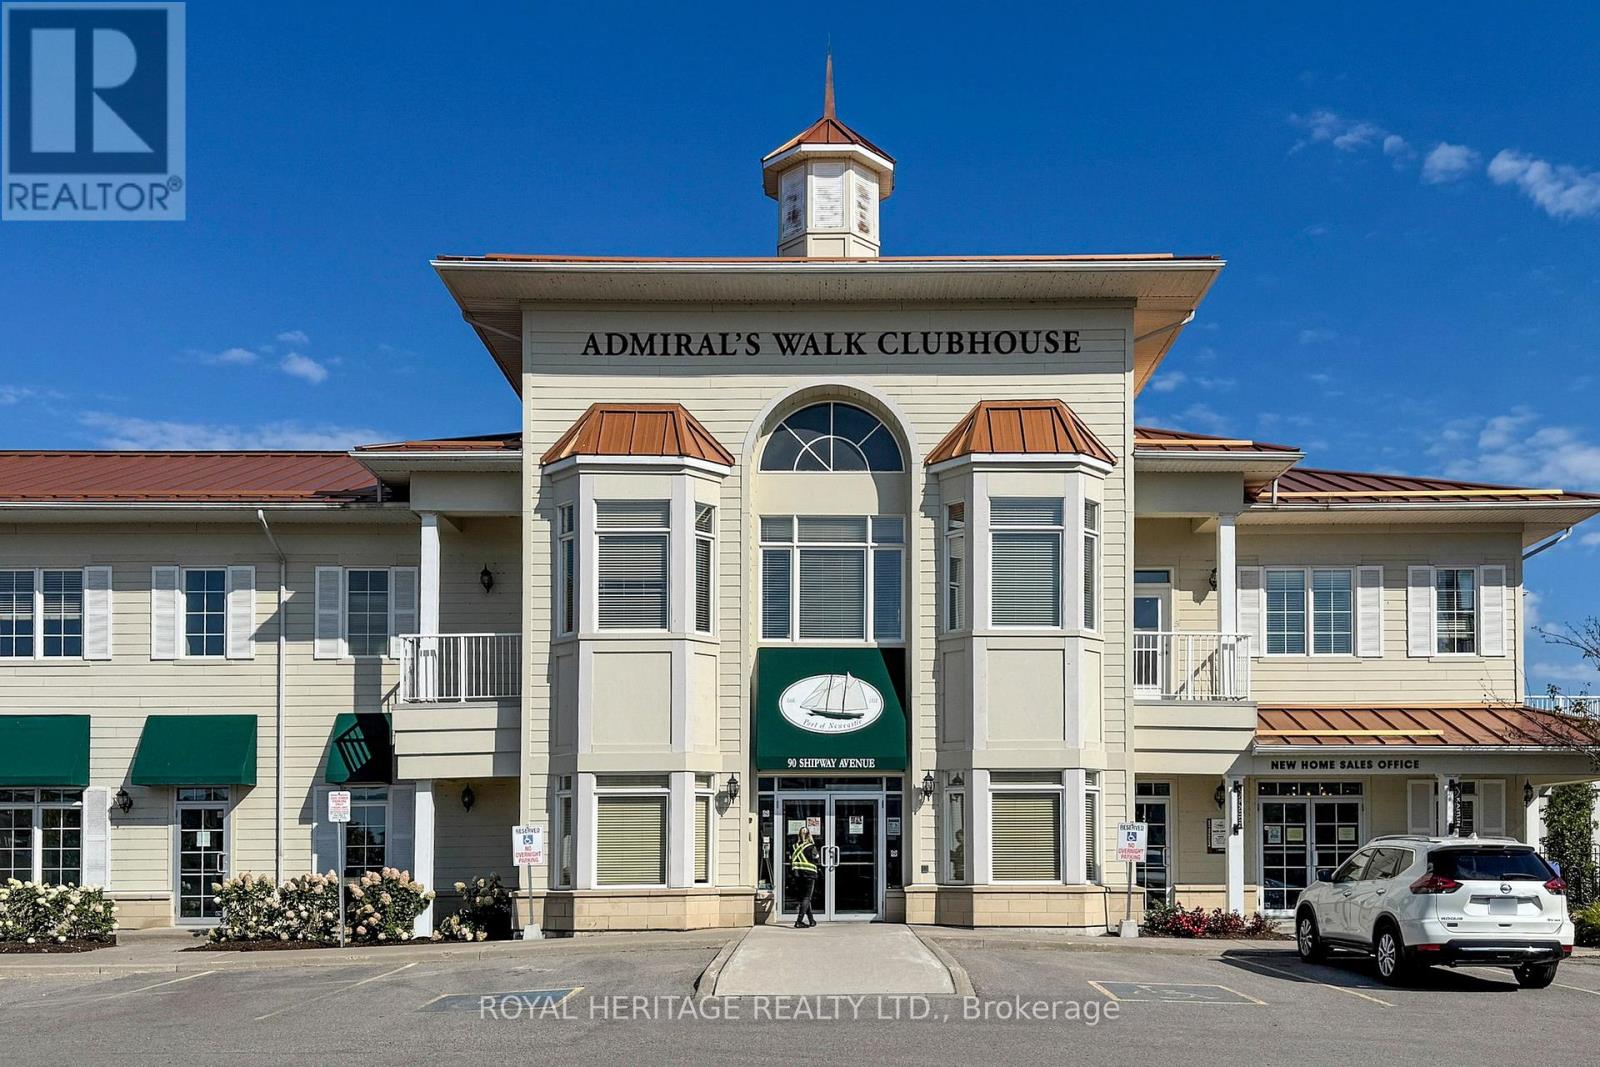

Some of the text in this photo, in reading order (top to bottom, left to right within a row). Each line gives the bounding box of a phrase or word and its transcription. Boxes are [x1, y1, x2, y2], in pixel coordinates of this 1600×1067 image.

[581, 330, 1081, 357] ADMIRAL'S WALK CLUBHOUSE
[787, 758, 876, 768] 90 SHIPWAY AVENUE
[1271, 760, 1420, 769] NEW HOME SALES OFFICE
